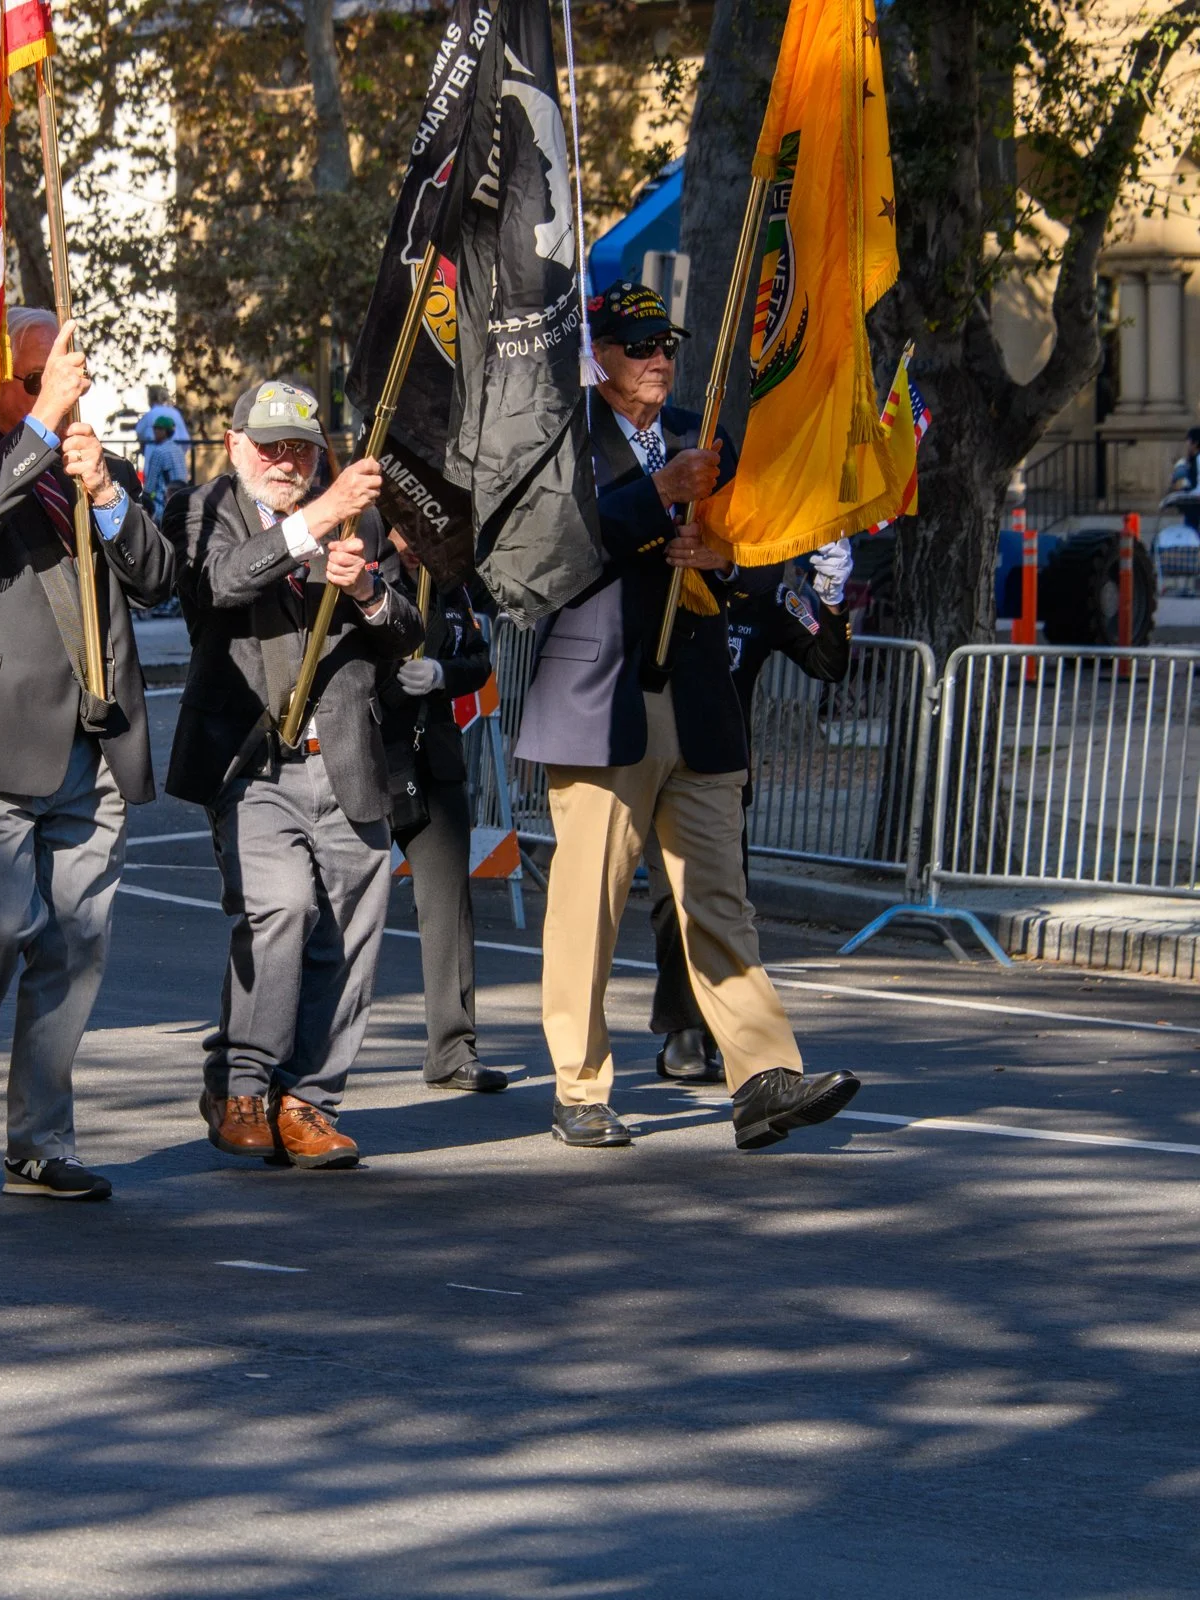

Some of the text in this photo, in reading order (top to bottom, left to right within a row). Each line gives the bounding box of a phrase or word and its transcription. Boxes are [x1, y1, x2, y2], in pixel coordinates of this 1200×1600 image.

[411, 8, 493, 156] CHAPTER 201
[497, 304, 582, 359] YOU ARE NOT
[378, 453, 452, 534] AMERICA
